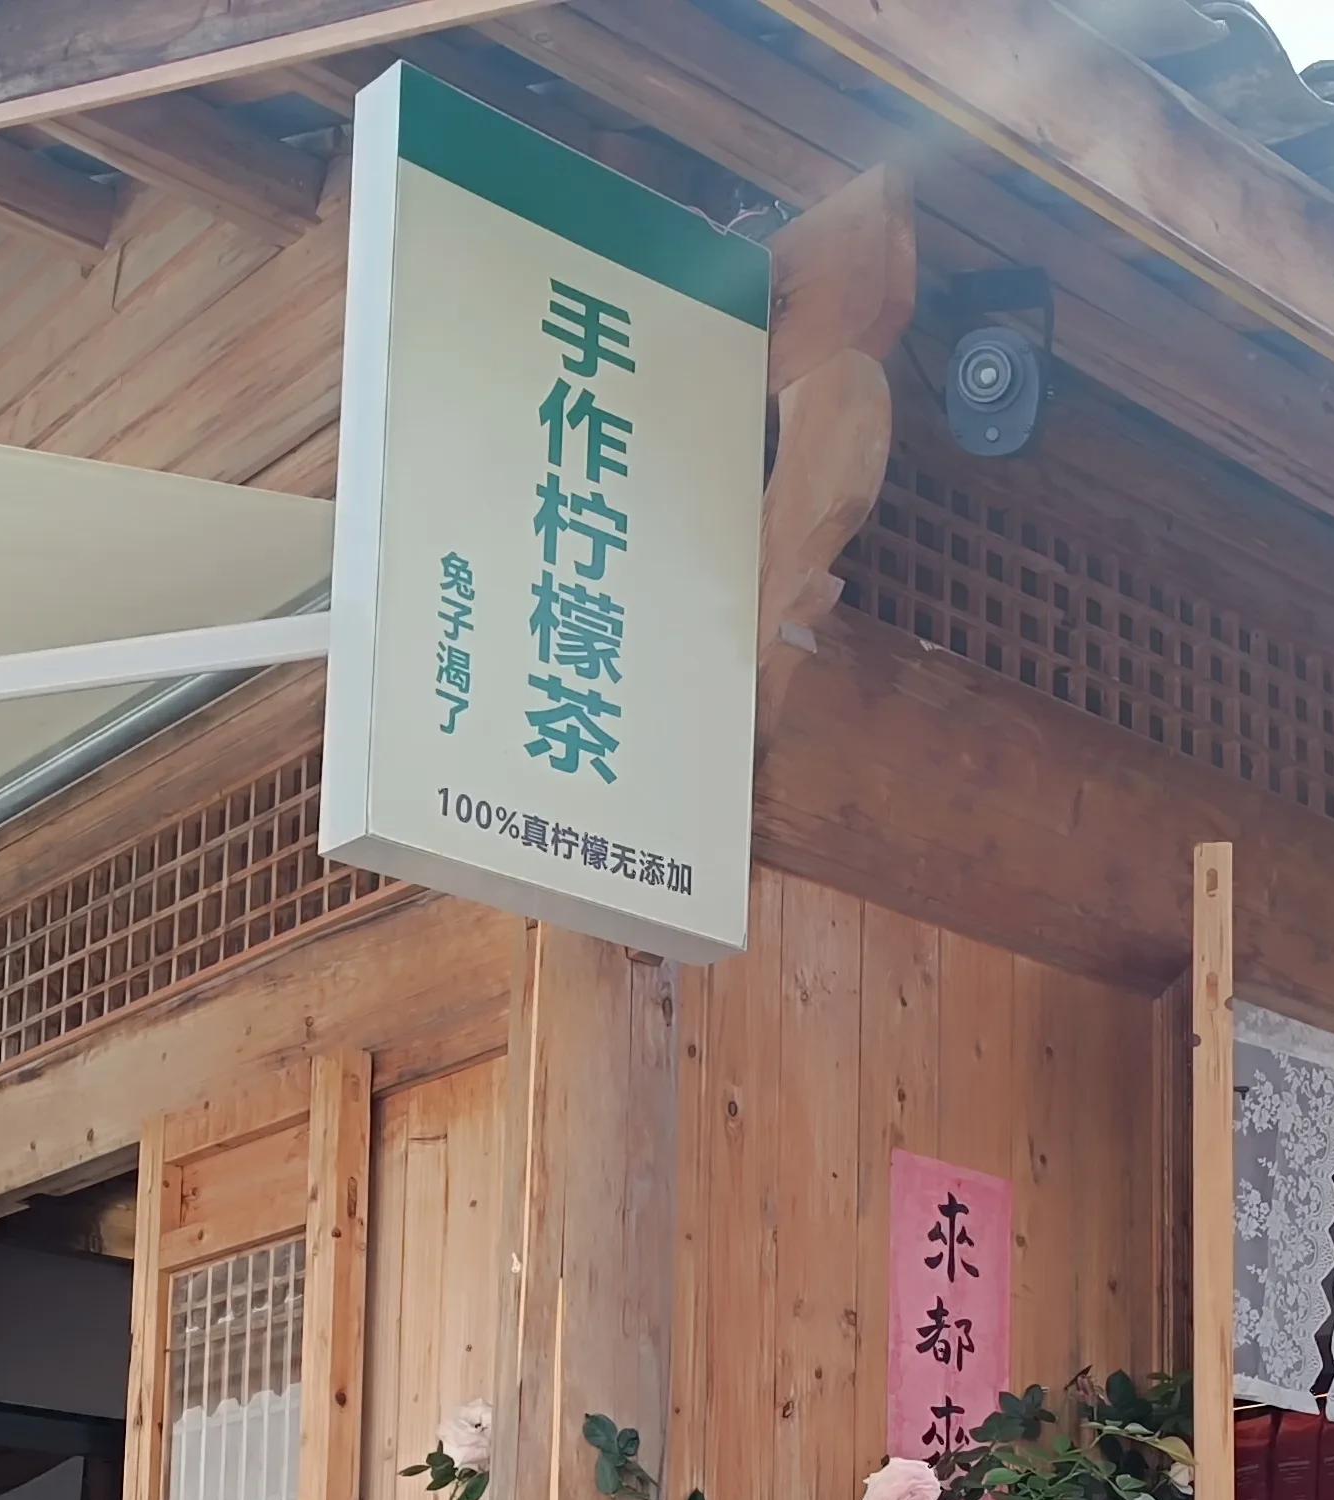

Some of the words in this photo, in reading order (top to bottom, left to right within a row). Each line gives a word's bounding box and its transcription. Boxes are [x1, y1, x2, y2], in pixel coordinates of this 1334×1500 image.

[523, 276, 637, 785] 手作柠檬茶
[433, 550, 477, 736] 兔子渴了
[437, 785, 694, 897] 100%真柠檬无添加
